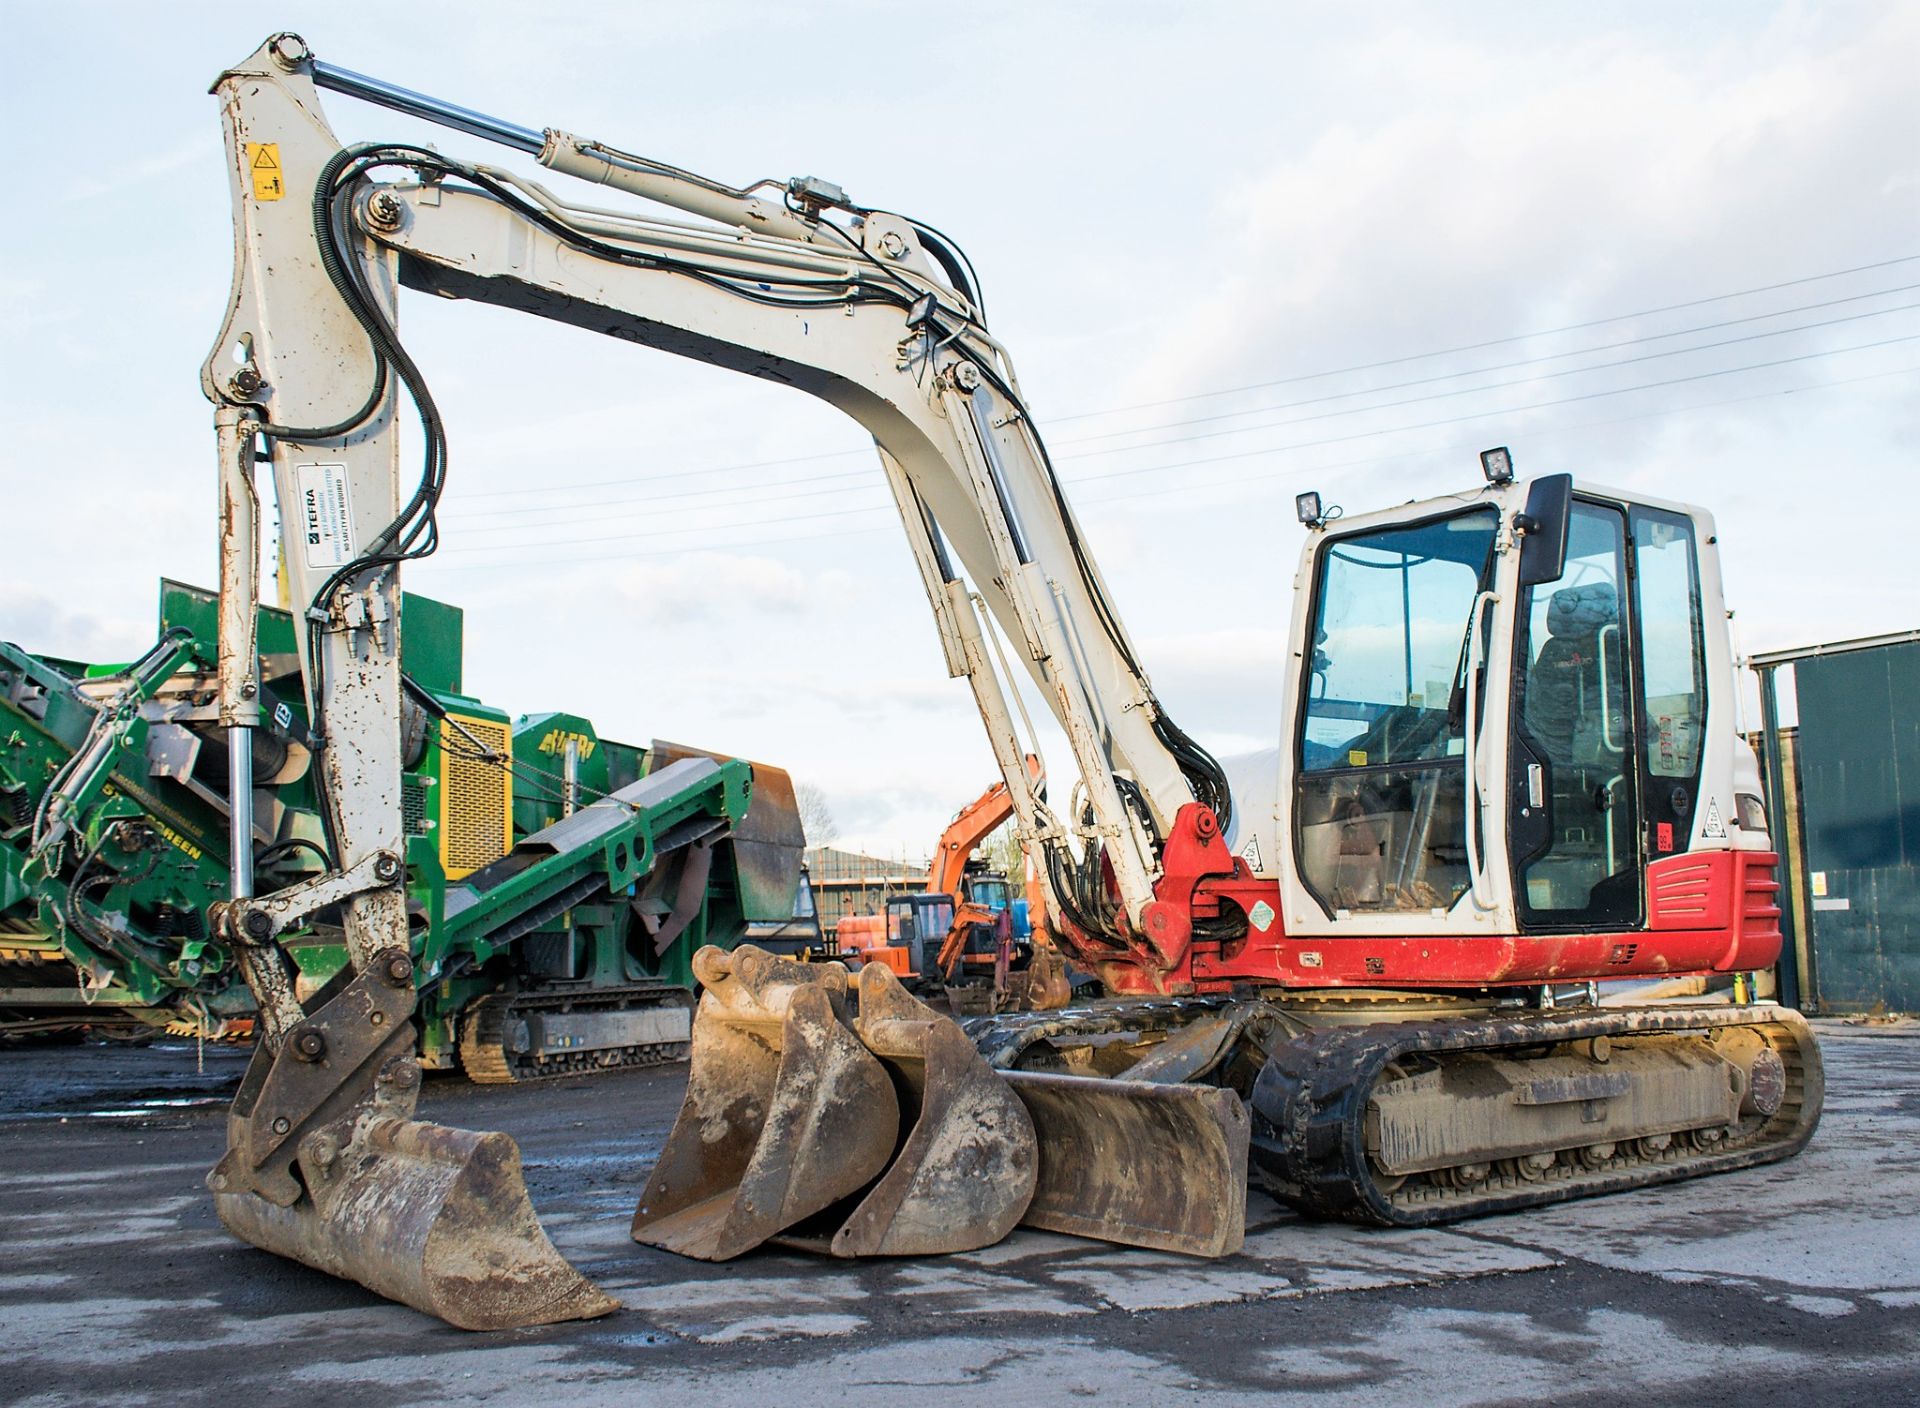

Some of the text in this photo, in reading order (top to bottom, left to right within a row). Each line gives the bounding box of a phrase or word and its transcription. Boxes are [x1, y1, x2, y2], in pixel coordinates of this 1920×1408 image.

[328, 489, 336, 514] COUPLER
[336, 479, 344, 508] REQUIRED
[306, 489, 318, 530] TEFRA
[344, 542, 350, 551] NO
